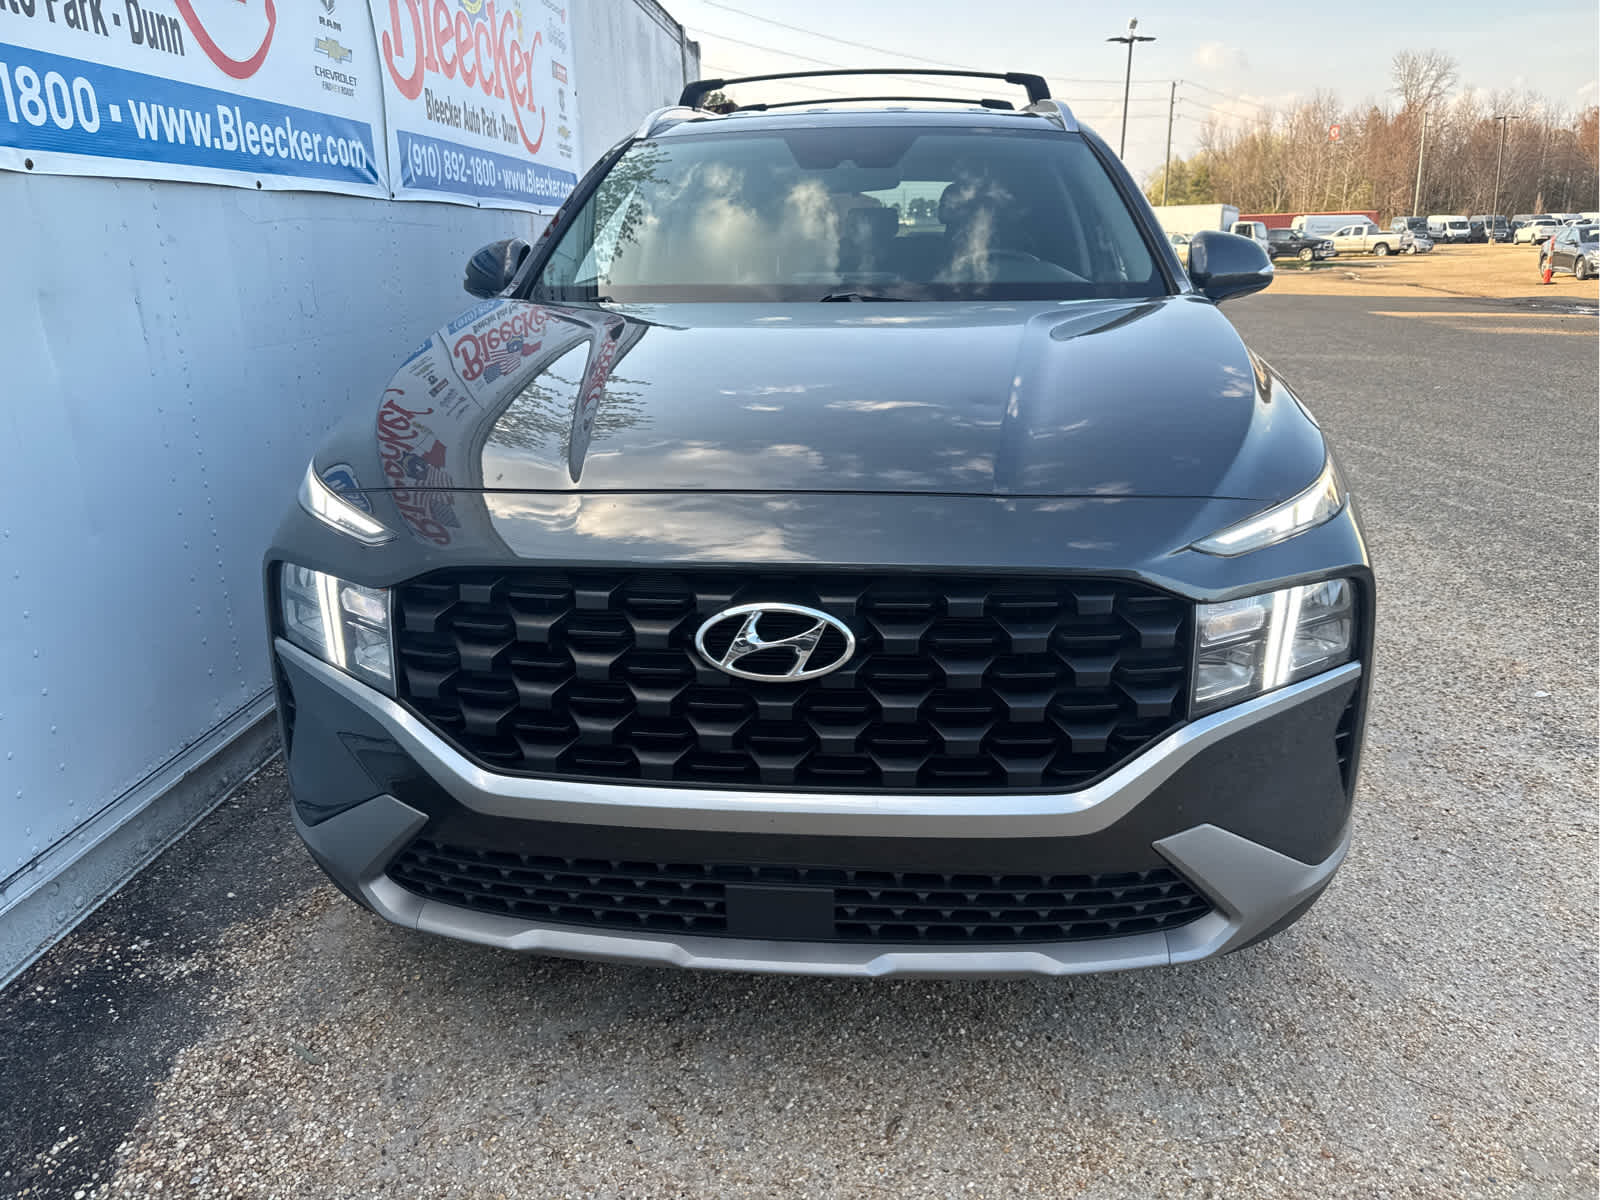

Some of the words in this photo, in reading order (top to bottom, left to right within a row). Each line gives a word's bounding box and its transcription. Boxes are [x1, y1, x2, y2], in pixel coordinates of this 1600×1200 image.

[125, 0, 185, 56] Dunn
[318, 16, 341, 32] RAM
[314, 65, 357, 87] CHEVROLET
[382, 0, 545, 154] Bleecker
[128, 99, 366, 169] www.Bleecker.com
[424, 87, 463, 129] Bleecker
[463, 101, 480, 134] Auto
[480, 107, 498, 138] Park
[407, 138, 442, 185] (910)
[443, 151, 496, 187] 892-1800
